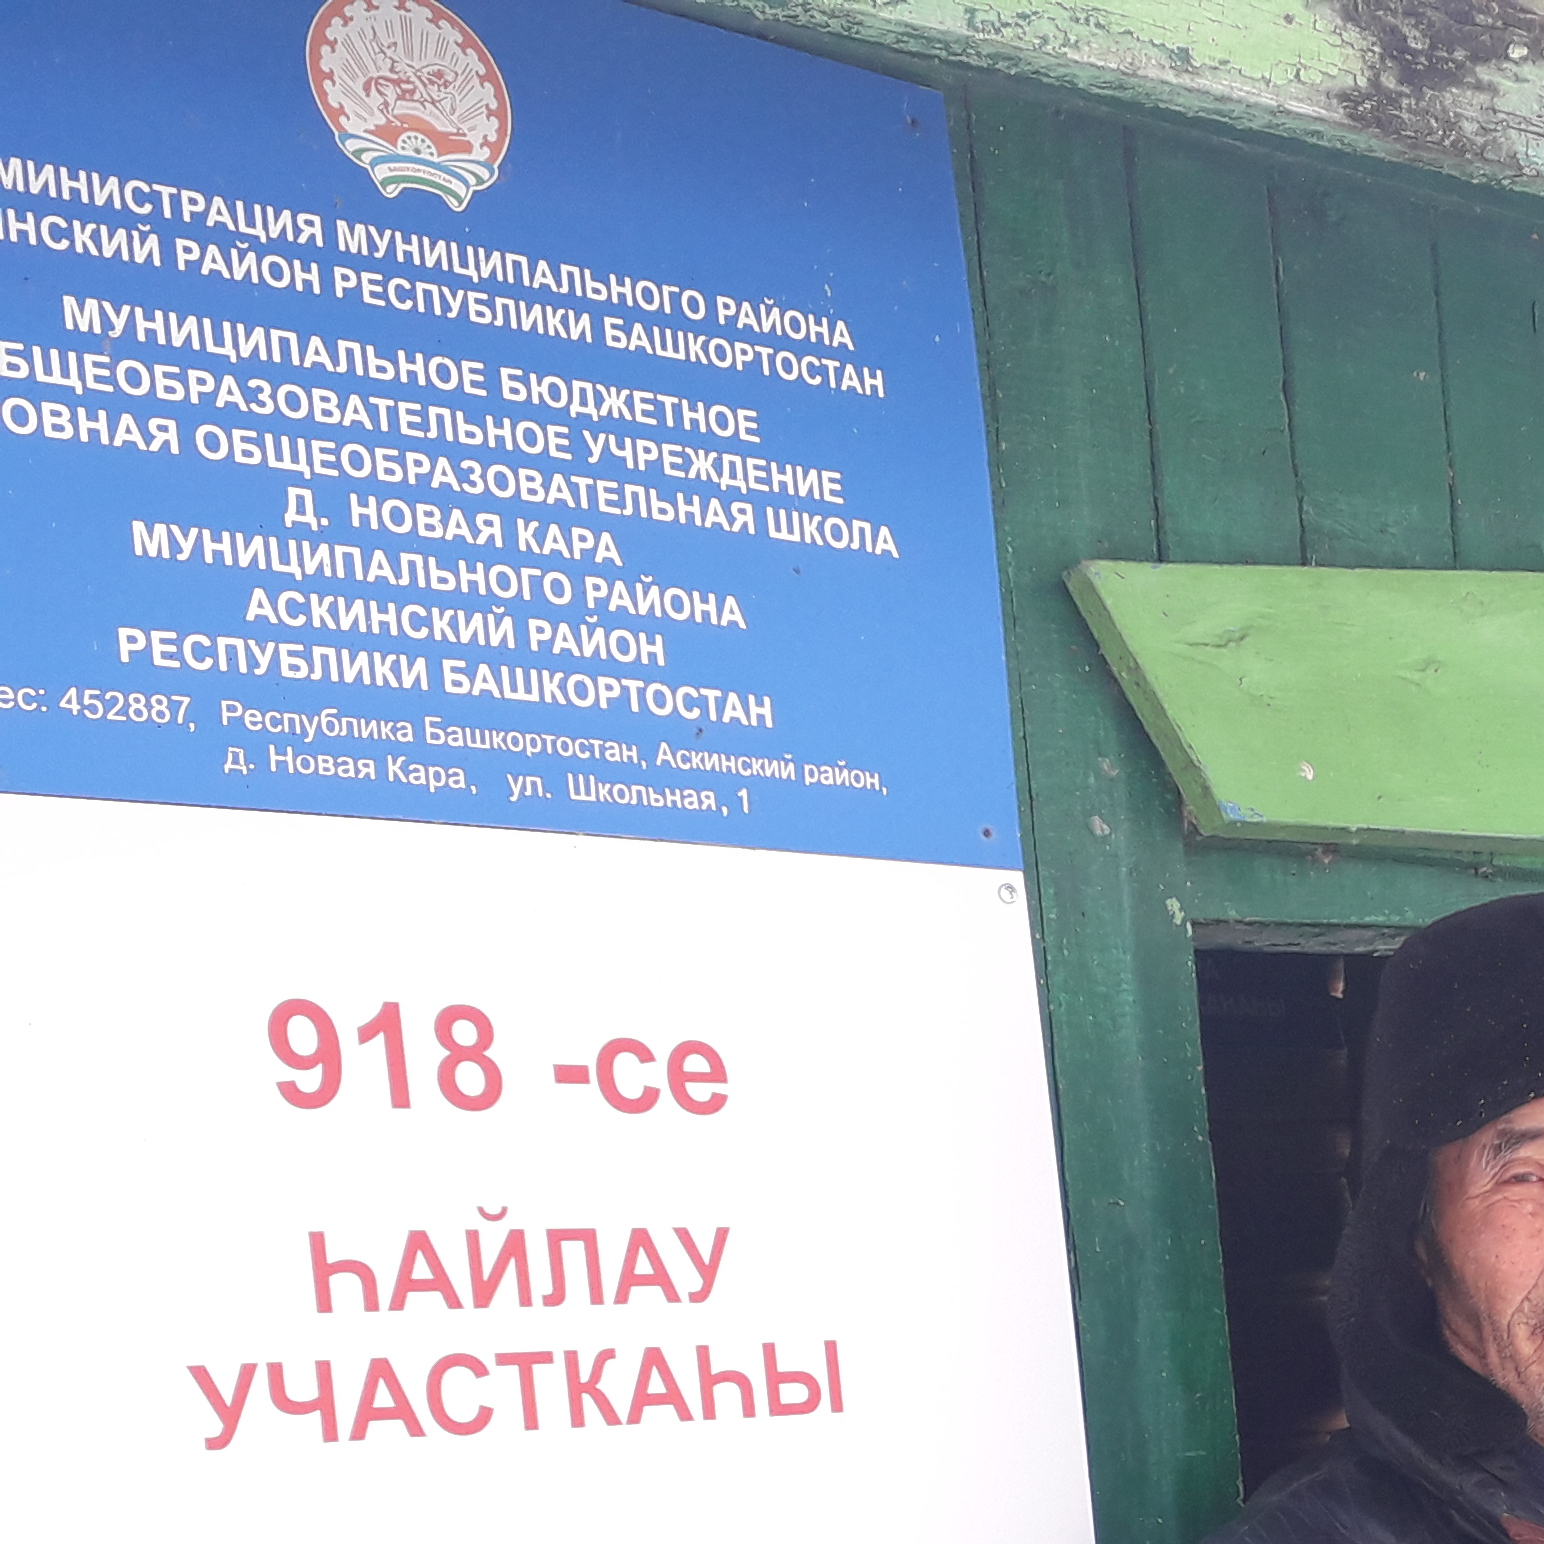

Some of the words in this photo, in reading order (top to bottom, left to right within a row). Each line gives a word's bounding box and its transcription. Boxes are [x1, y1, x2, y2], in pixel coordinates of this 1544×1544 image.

[0, 208, 161, 267] НСКИЙ
[175, 237, 321, 295] РАЙОН
[333, 266, 593, 343] РЕСПУБЛИКИ
[603, 316, 885, 398] БАШКОРТОСТАН
[336, 219, 706, 321] МУНИЦИПАЛЬНОГО
[716, 295, 855, 351] РАЙОНА
[62, 295, 488, 397] МУНИЦИПАЛЬНОЕ
[499, 366, 761, 444] БЮДЖЕТНОЕ
[1, 397, 180, 455] ОВНАЯ
[195, 424, 756, 535] ОБЩЕОБРАЗОВАТЕЛЬНАЯ
[765, 506, 900, 559] ШКОЛА
[582, 429, 845, 505] УЧРЕЖДЕНИЕ
[131, 520, 573, 605] МУНИЦИПАЛЬНОГО
[584, 574, 747, 630] РАЙОНА
[284, 486, 329, 532] Д.
[349, 492, 503, 548] НОВАЯ
[516, 517, 624, 567] КАРА
[117, 627, 429, 691] РЕСПУБЛИКИ
[441, 658, 773, 729] БАШКОРТОСТАН
[245, 587, 516, 649] АСКИНСКИЙ
[527, 614, 666, 667] РАЙОН
[59, 686, 195, 733] 452887,
[220, 700, 414, 743] Республика
[424, 716, 647, 770] Башкортостан,
[655, 741, 796, 781] Аскинский
[803, 760, 887, 796] район,
[223, 746, 255, 775] д.
[268, 744, 376, 780] Новая
[387, 754, 477, 795] Кара,
[506, 773, 552, 802] ул.
[567, 772, 728, 817] Школьная,
[737, 787, 749, 814] 1
[267, 997, 505, 1113] 918
[552, 1036, 730, 1117] -се
[308, 1205, 731, 1315] ҺАЙЛАУ
[187, 1339, 845, 1452] УЧАСТКАҺЫ
